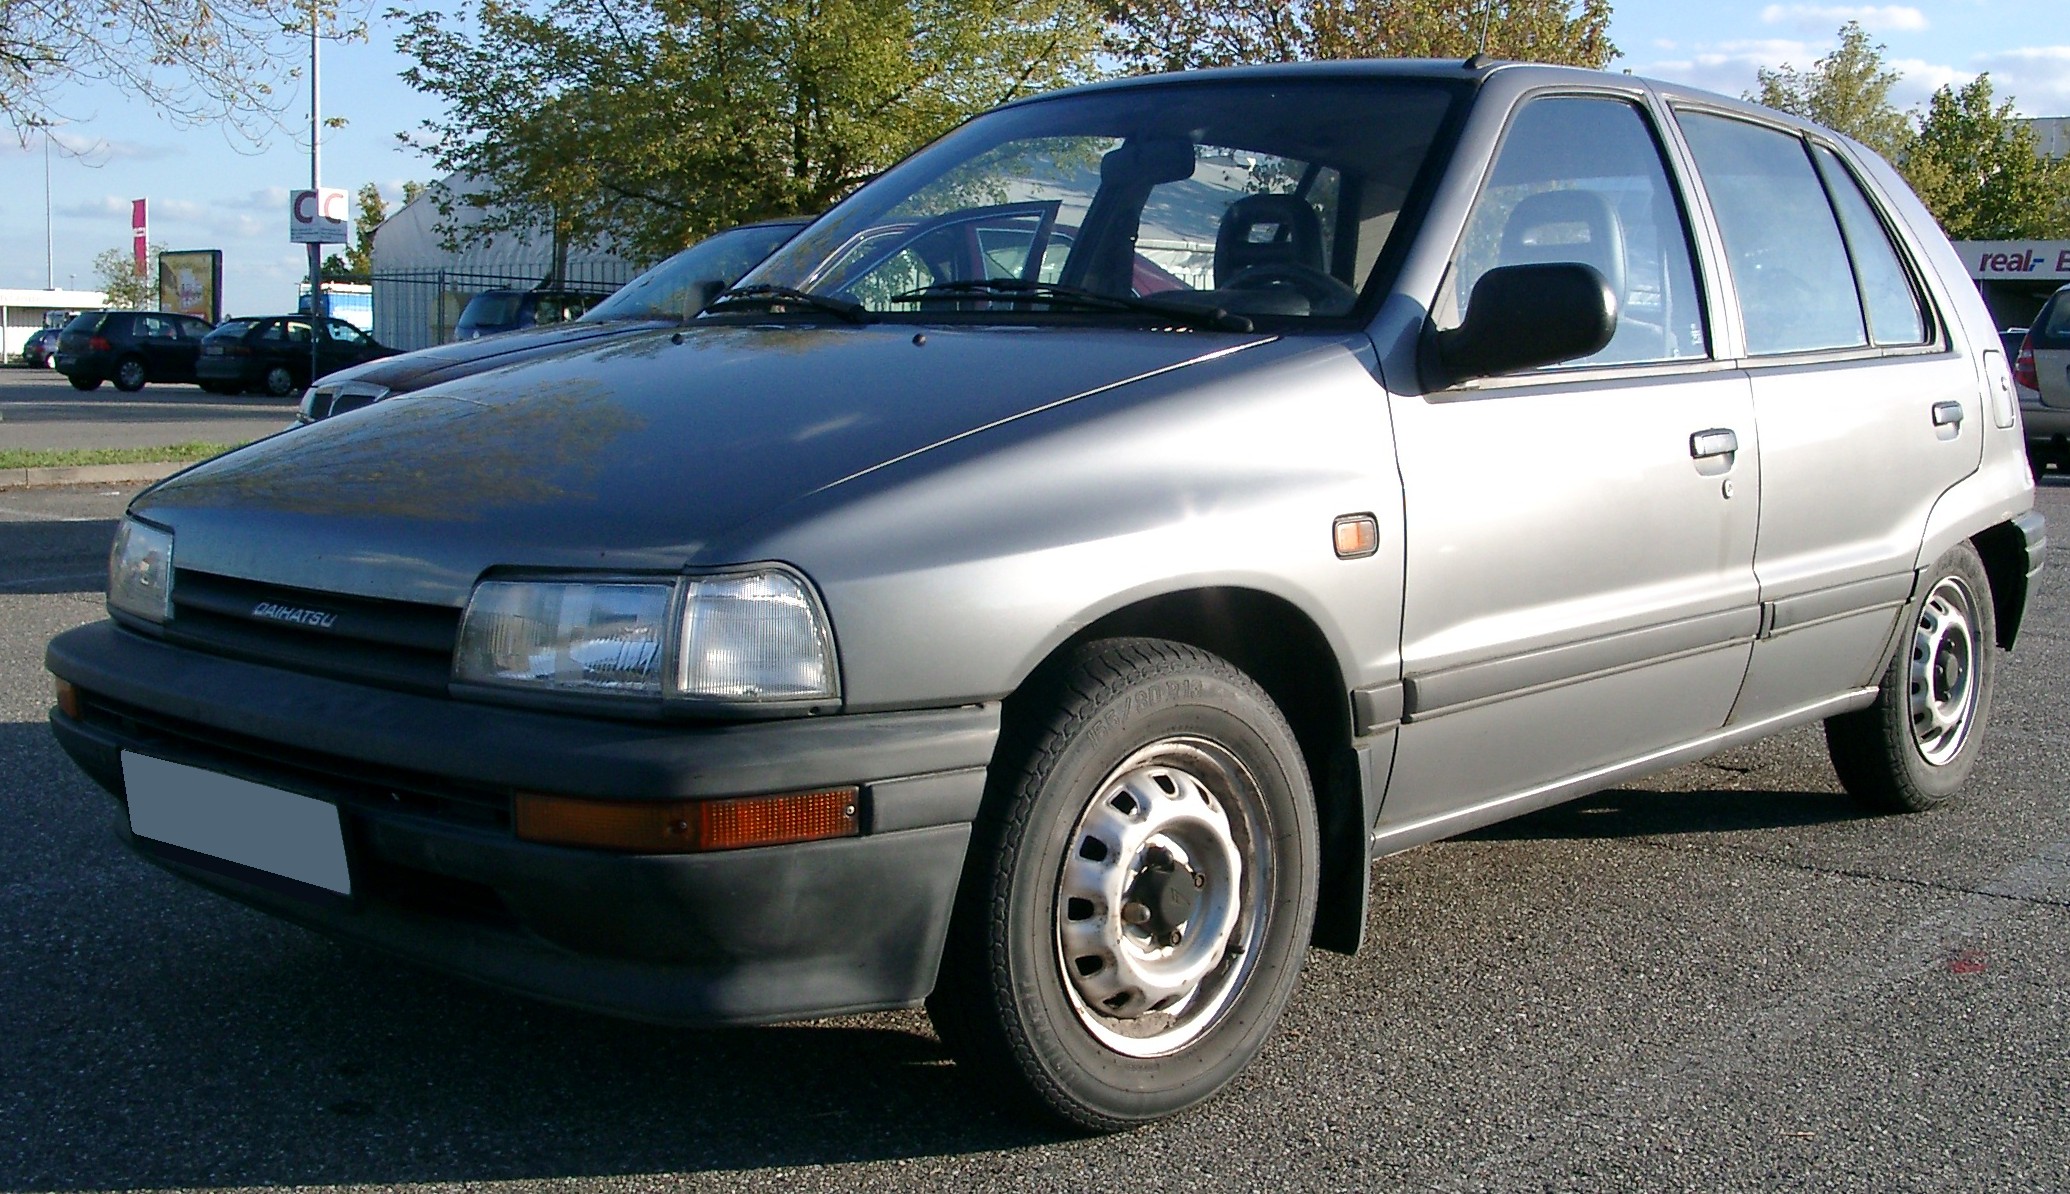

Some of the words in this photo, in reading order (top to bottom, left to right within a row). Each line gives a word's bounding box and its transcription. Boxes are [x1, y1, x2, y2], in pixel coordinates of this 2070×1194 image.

[294, 191, 317, 224] C
[324, 193, 343, 225] C
[252, 602, 338, 628] DAIHATSU
